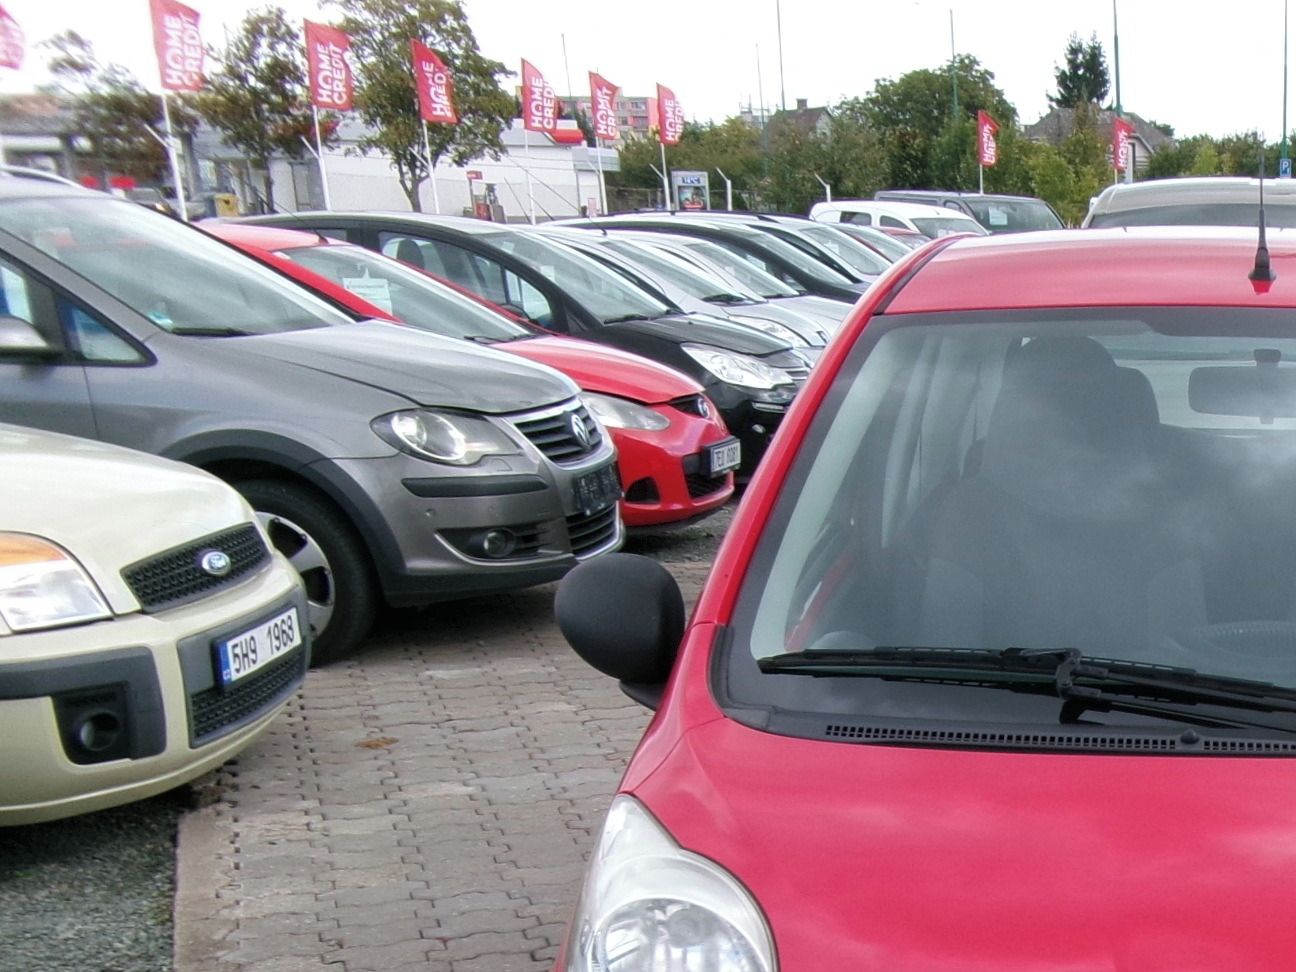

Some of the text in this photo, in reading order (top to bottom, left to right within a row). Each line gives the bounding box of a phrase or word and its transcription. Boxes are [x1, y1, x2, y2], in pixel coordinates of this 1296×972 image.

[163, 13, 184, 84] HOME
[317, 41, 333, 103] HOME
[329, 41, 348, 105] CREDIT
[530, 76, 544, 128] HOME
[664, 98, 675, 141] HOME
[231, 614, 295, 674] 5H9 1968
